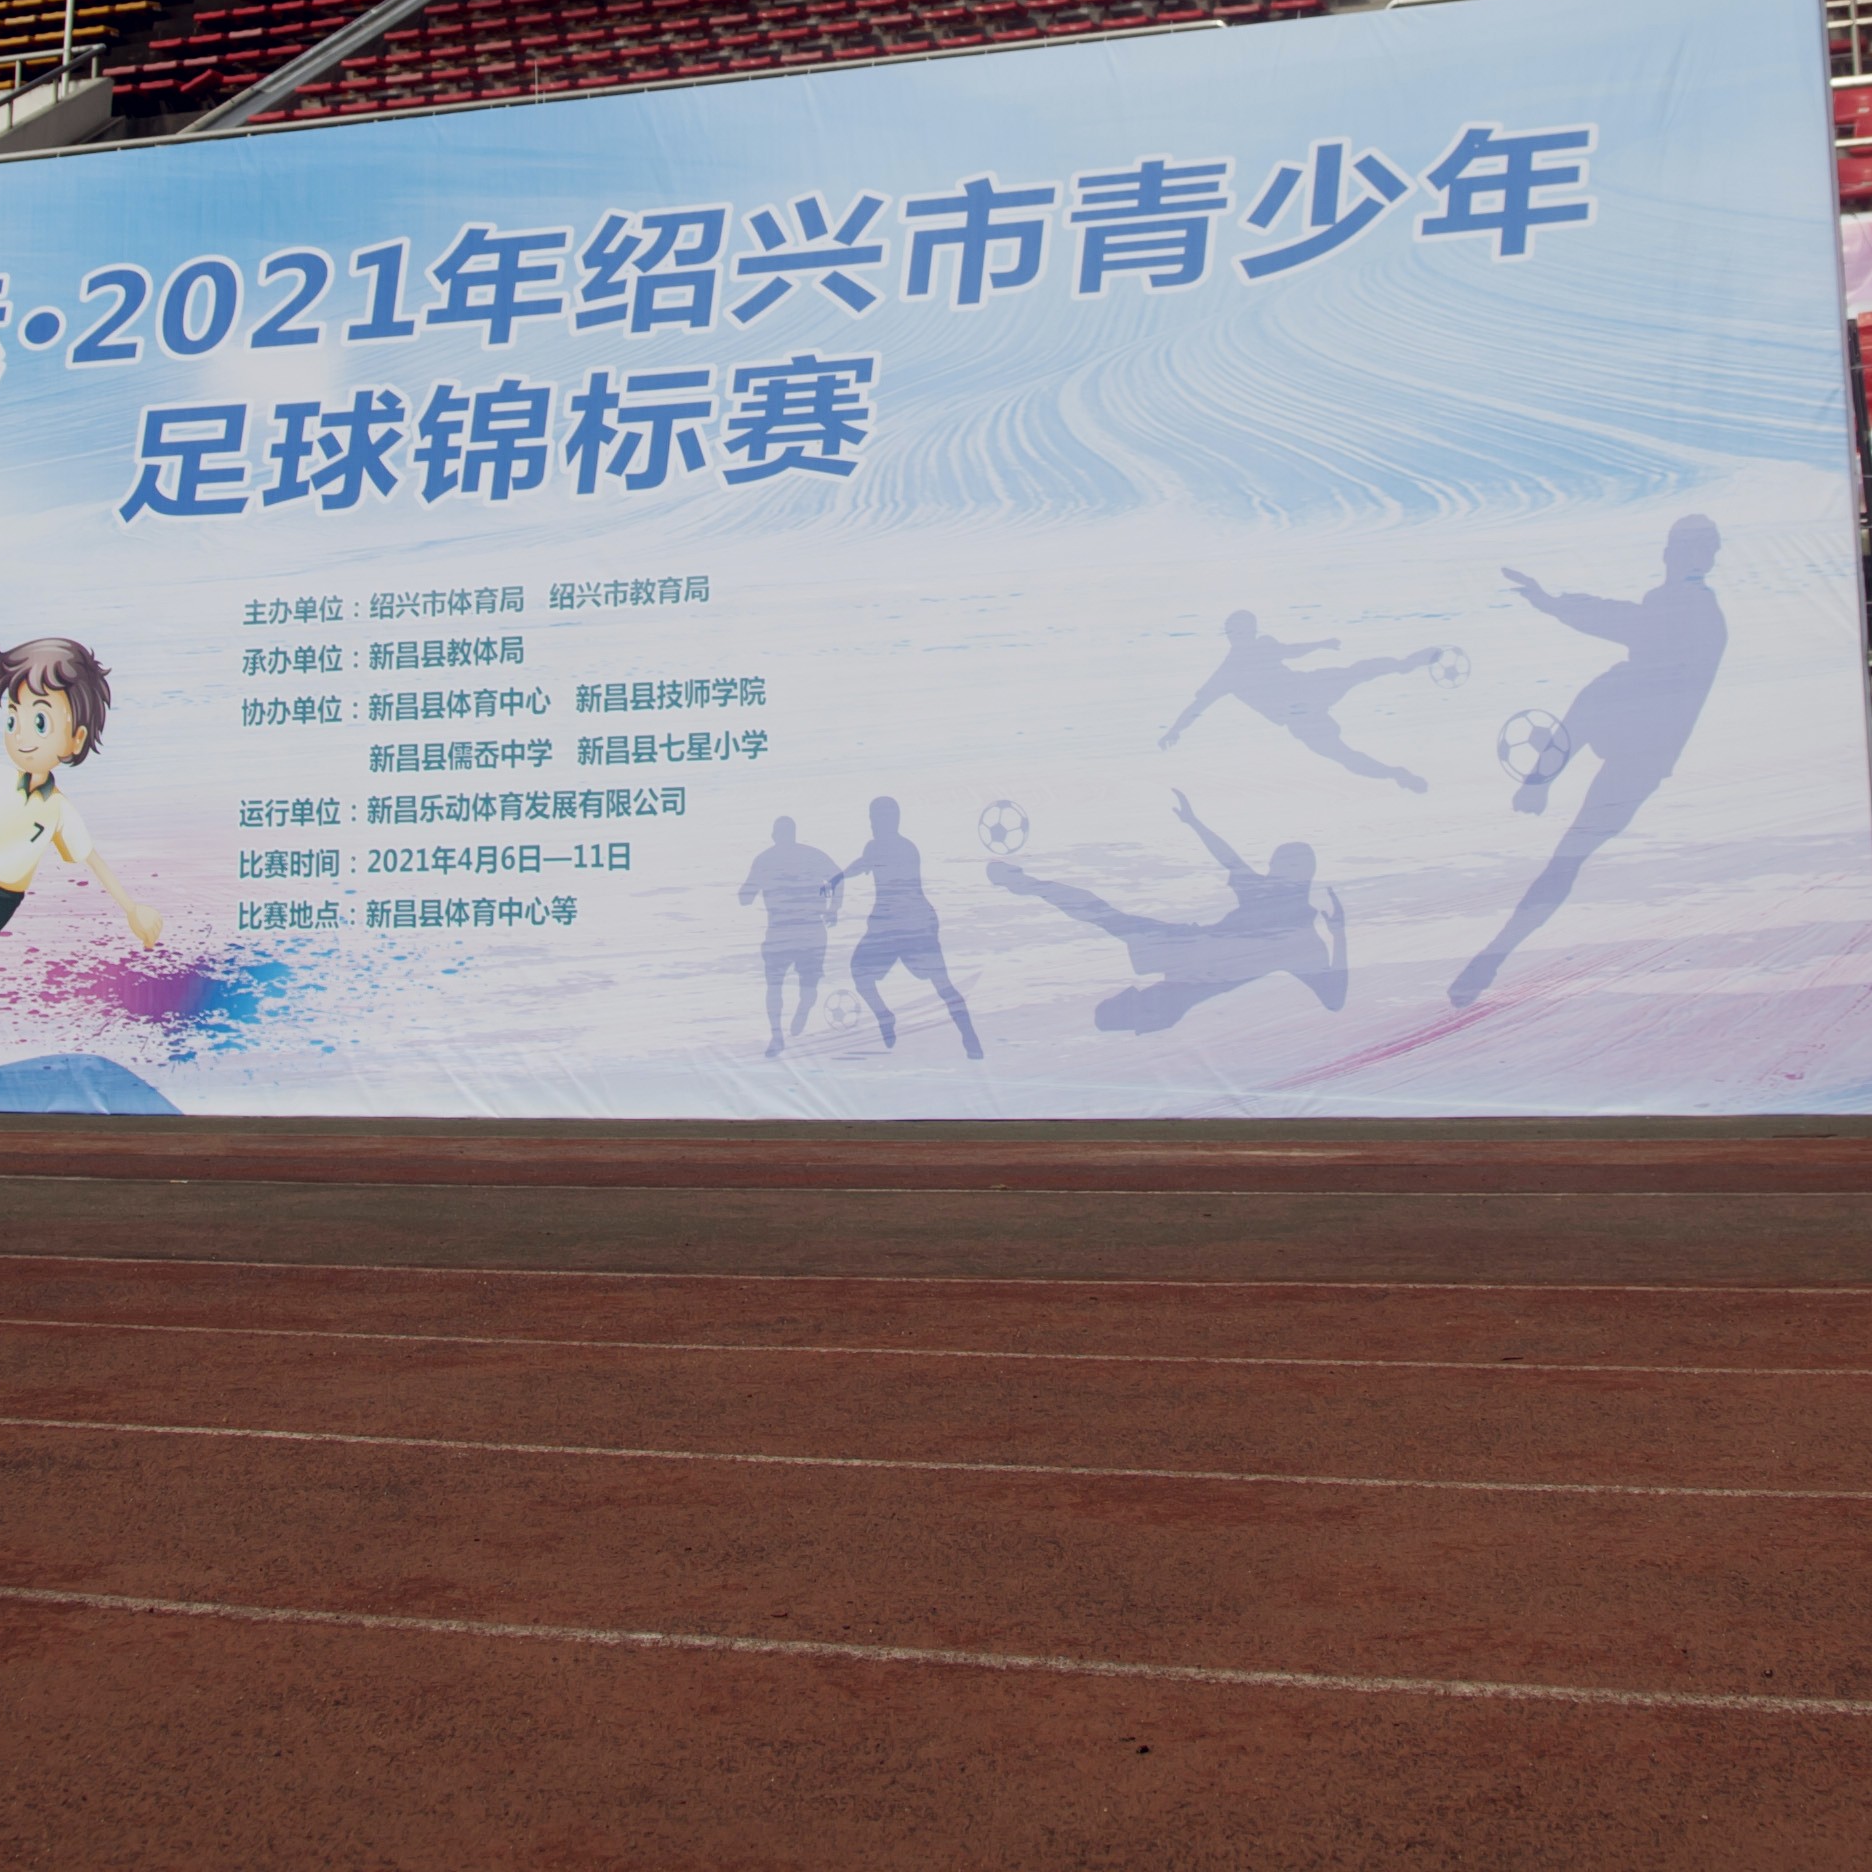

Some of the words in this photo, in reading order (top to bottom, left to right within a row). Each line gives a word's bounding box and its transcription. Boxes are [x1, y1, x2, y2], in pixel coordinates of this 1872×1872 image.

[120, 354, 874, 523] 足球锦标赛
[243, 585, 525, 626] 主办单位：绍兴市体育局
[549, 575, 710, 611] 绍兴市教育局
[242, 636, 525, 676] 承办单位：新昌县教体局
[241, 686, 552, 727] 协办单位：新昌县体育中心
[575, 676, 767, 714] 新昌县技师学院
[369, 738, 553, 773] 新昌县儒岙中学
[577, 729, 769, 766] 新昌县七星小学
[239, 786, 686, 828] 运行单位：新昌乐动体育发展有限公司
[238, 895, 578, 930] 比赛地点：新昌县体育中心等
